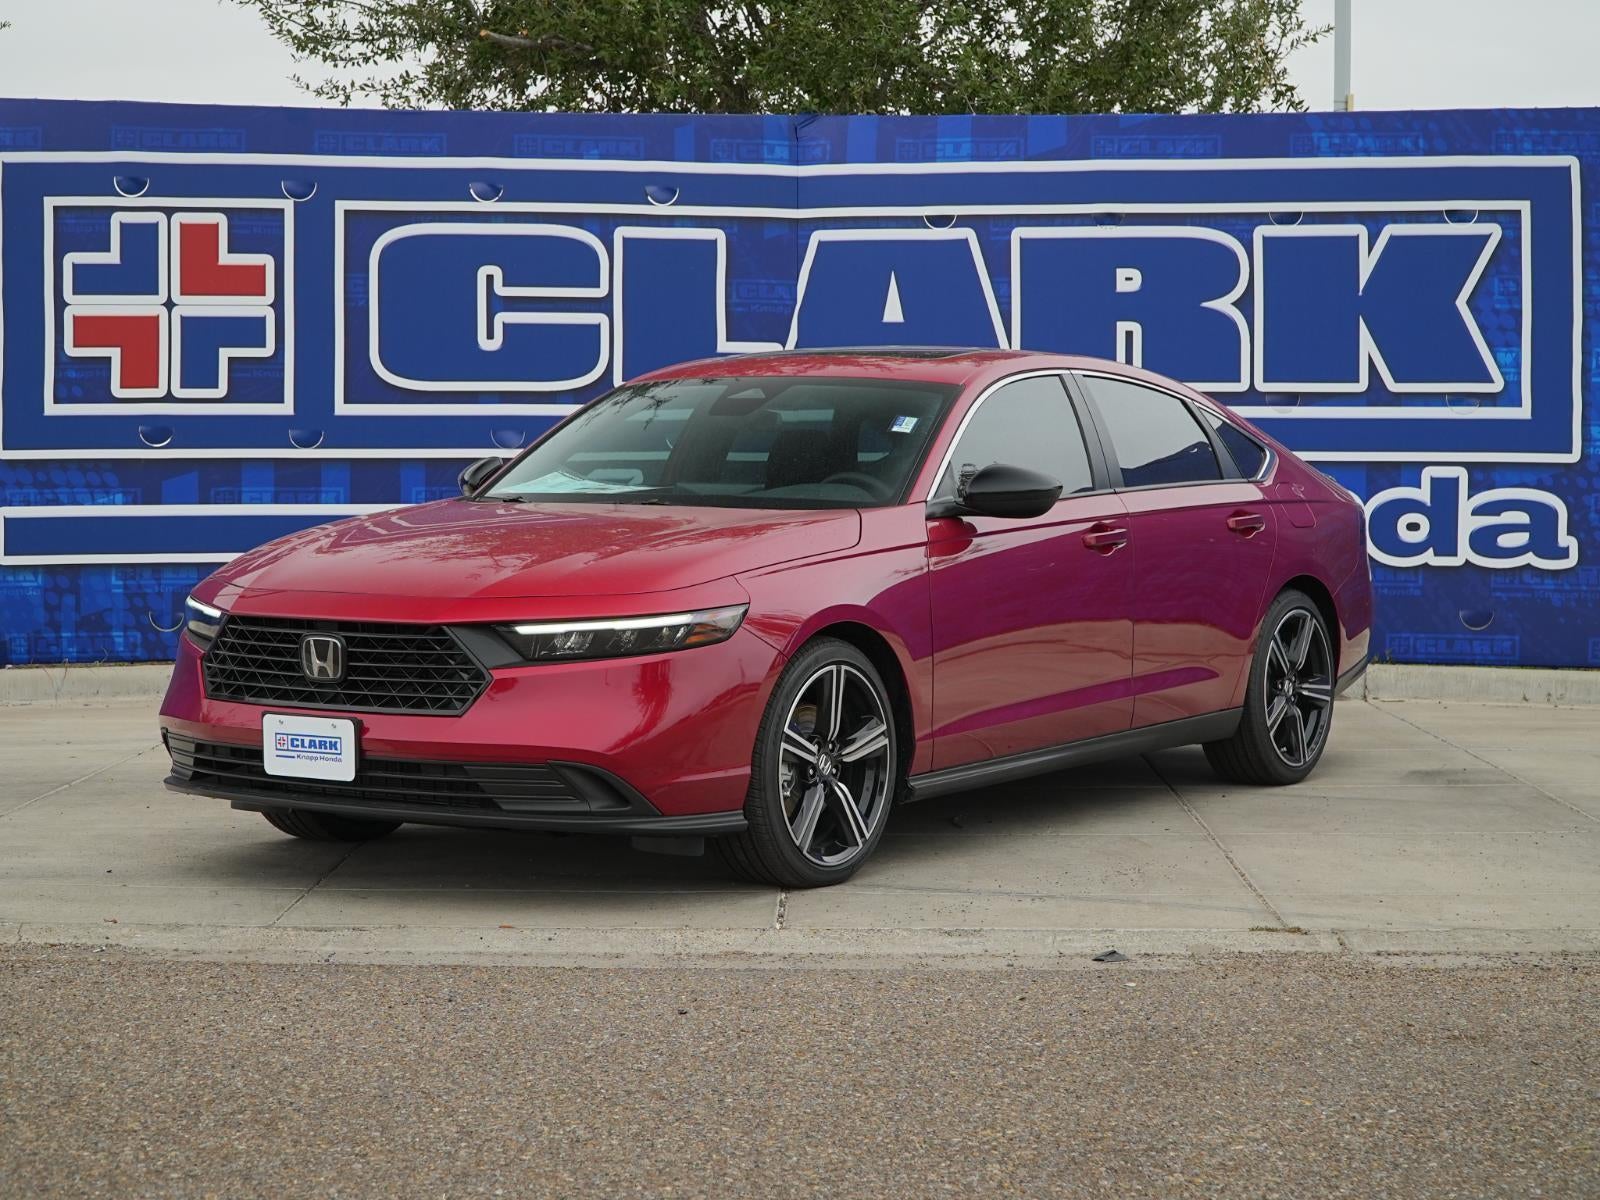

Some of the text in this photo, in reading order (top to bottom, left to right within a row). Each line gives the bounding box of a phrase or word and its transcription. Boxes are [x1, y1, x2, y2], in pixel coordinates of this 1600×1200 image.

[738, 283, 791, 300] CLA
[368, 222, 1503, 394] CLARK
[1416, 638, 1514, 655] CLARK
[290, 737, 338, 751] CLARK
[296, 753, 342, 763] Knapp Honda
